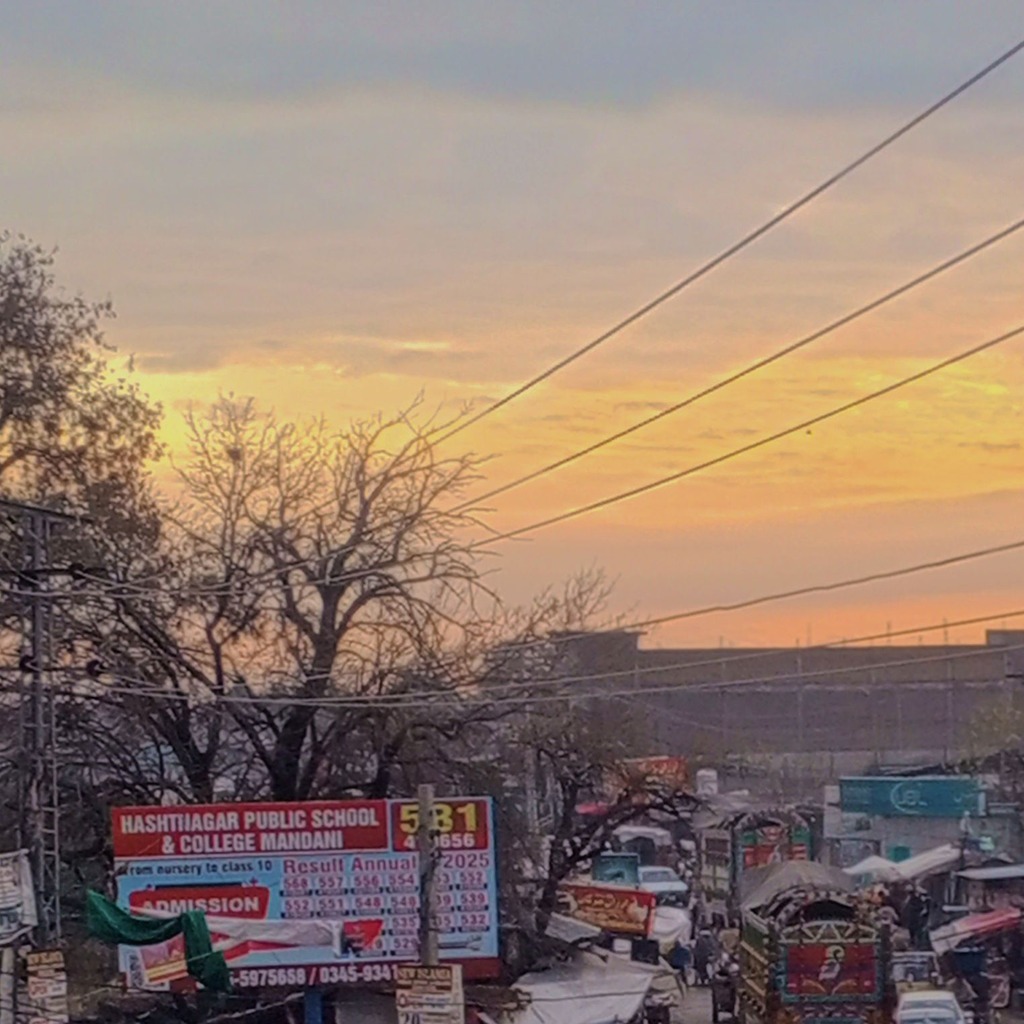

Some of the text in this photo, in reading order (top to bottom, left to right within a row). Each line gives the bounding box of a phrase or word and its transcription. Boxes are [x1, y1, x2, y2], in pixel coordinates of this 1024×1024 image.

[244, 809, 306, 830] PUBLIC
[311, 807, 380, 828] SCHOOL
[161, 830, 345, 854] & COLLEGE MANDANI
[157, 862, 202, 877] nursery
[206, 861, 219, 873] to
[223, 860, 254, 872] class
[258, 859, 273, 872] 10
[284, 853, 489, 874] Result Annual 2025
